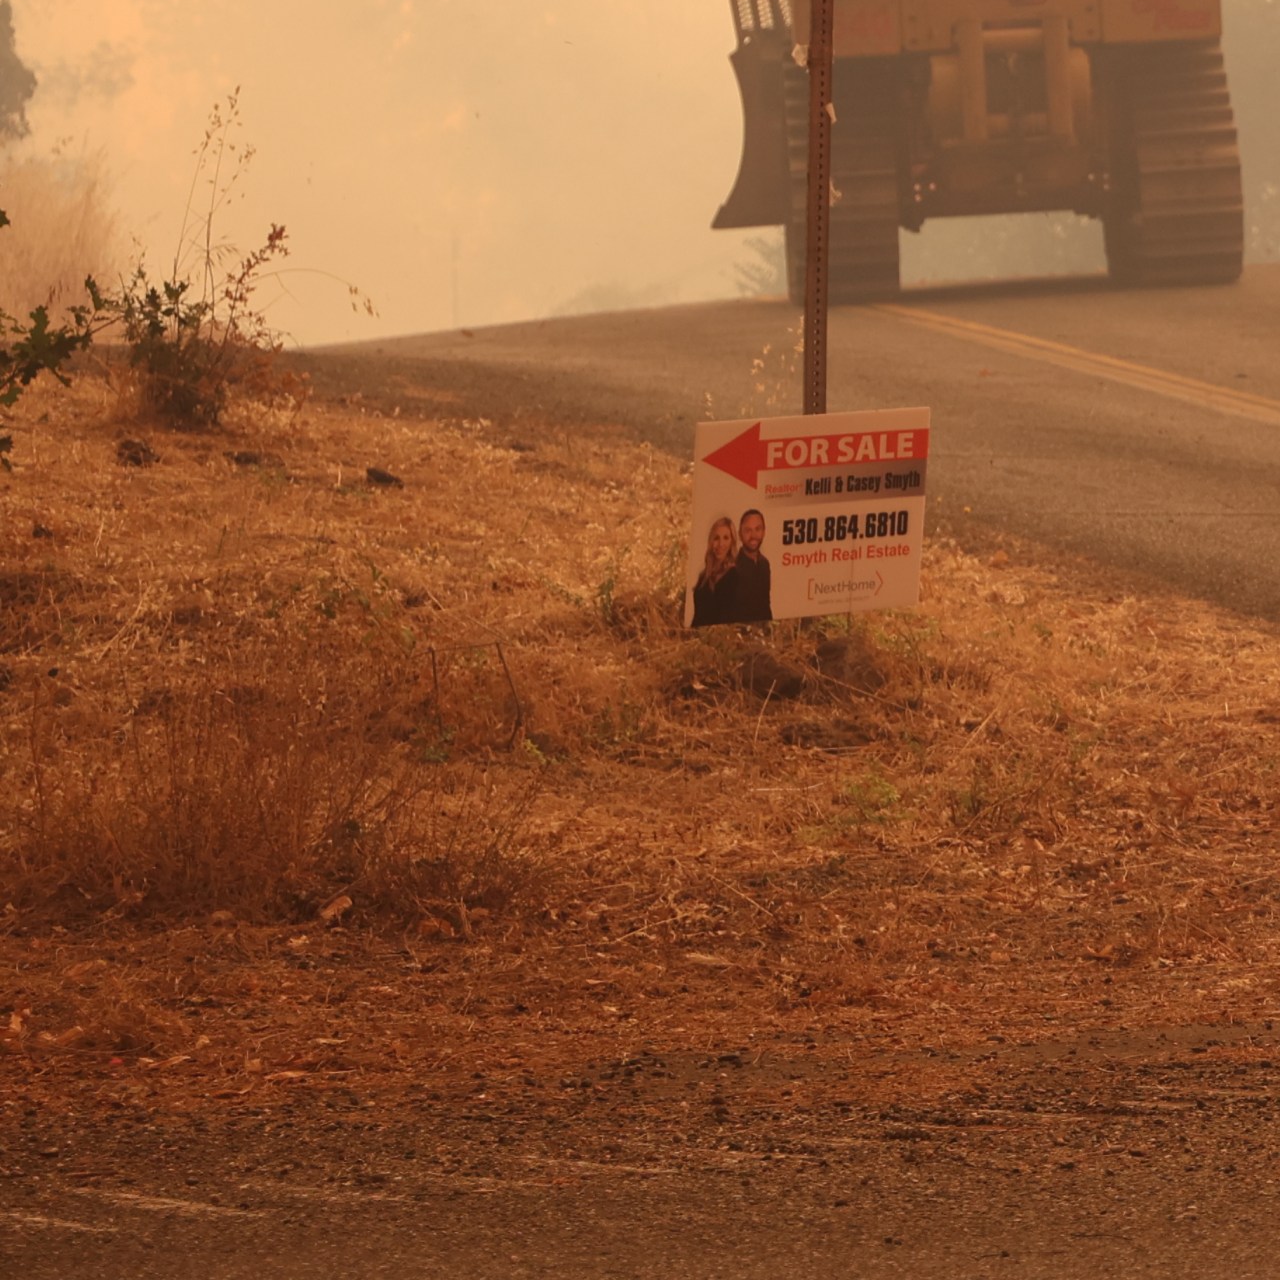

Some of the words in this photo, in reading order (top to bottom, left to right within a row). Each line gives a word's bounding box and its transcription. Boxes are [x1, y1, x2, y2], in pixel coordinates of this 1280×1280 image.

[767, 437, 829, 468] FOR
[837, 432, 914, 463] SALE
[805, 477, 832, 496] Kelli
[835, 476, 844, 493] &
[847, 474, 881, 494] Casey
[885, 471, 921, 492] Smyth
[782, 511, 909, 545] 530.864.6810
[782, 547, 827, 568] Smyth
[831, 545, 862, 562] Real
[866, 542, 911, 559] Estate
[814, 578, 876, 595] NextHome
